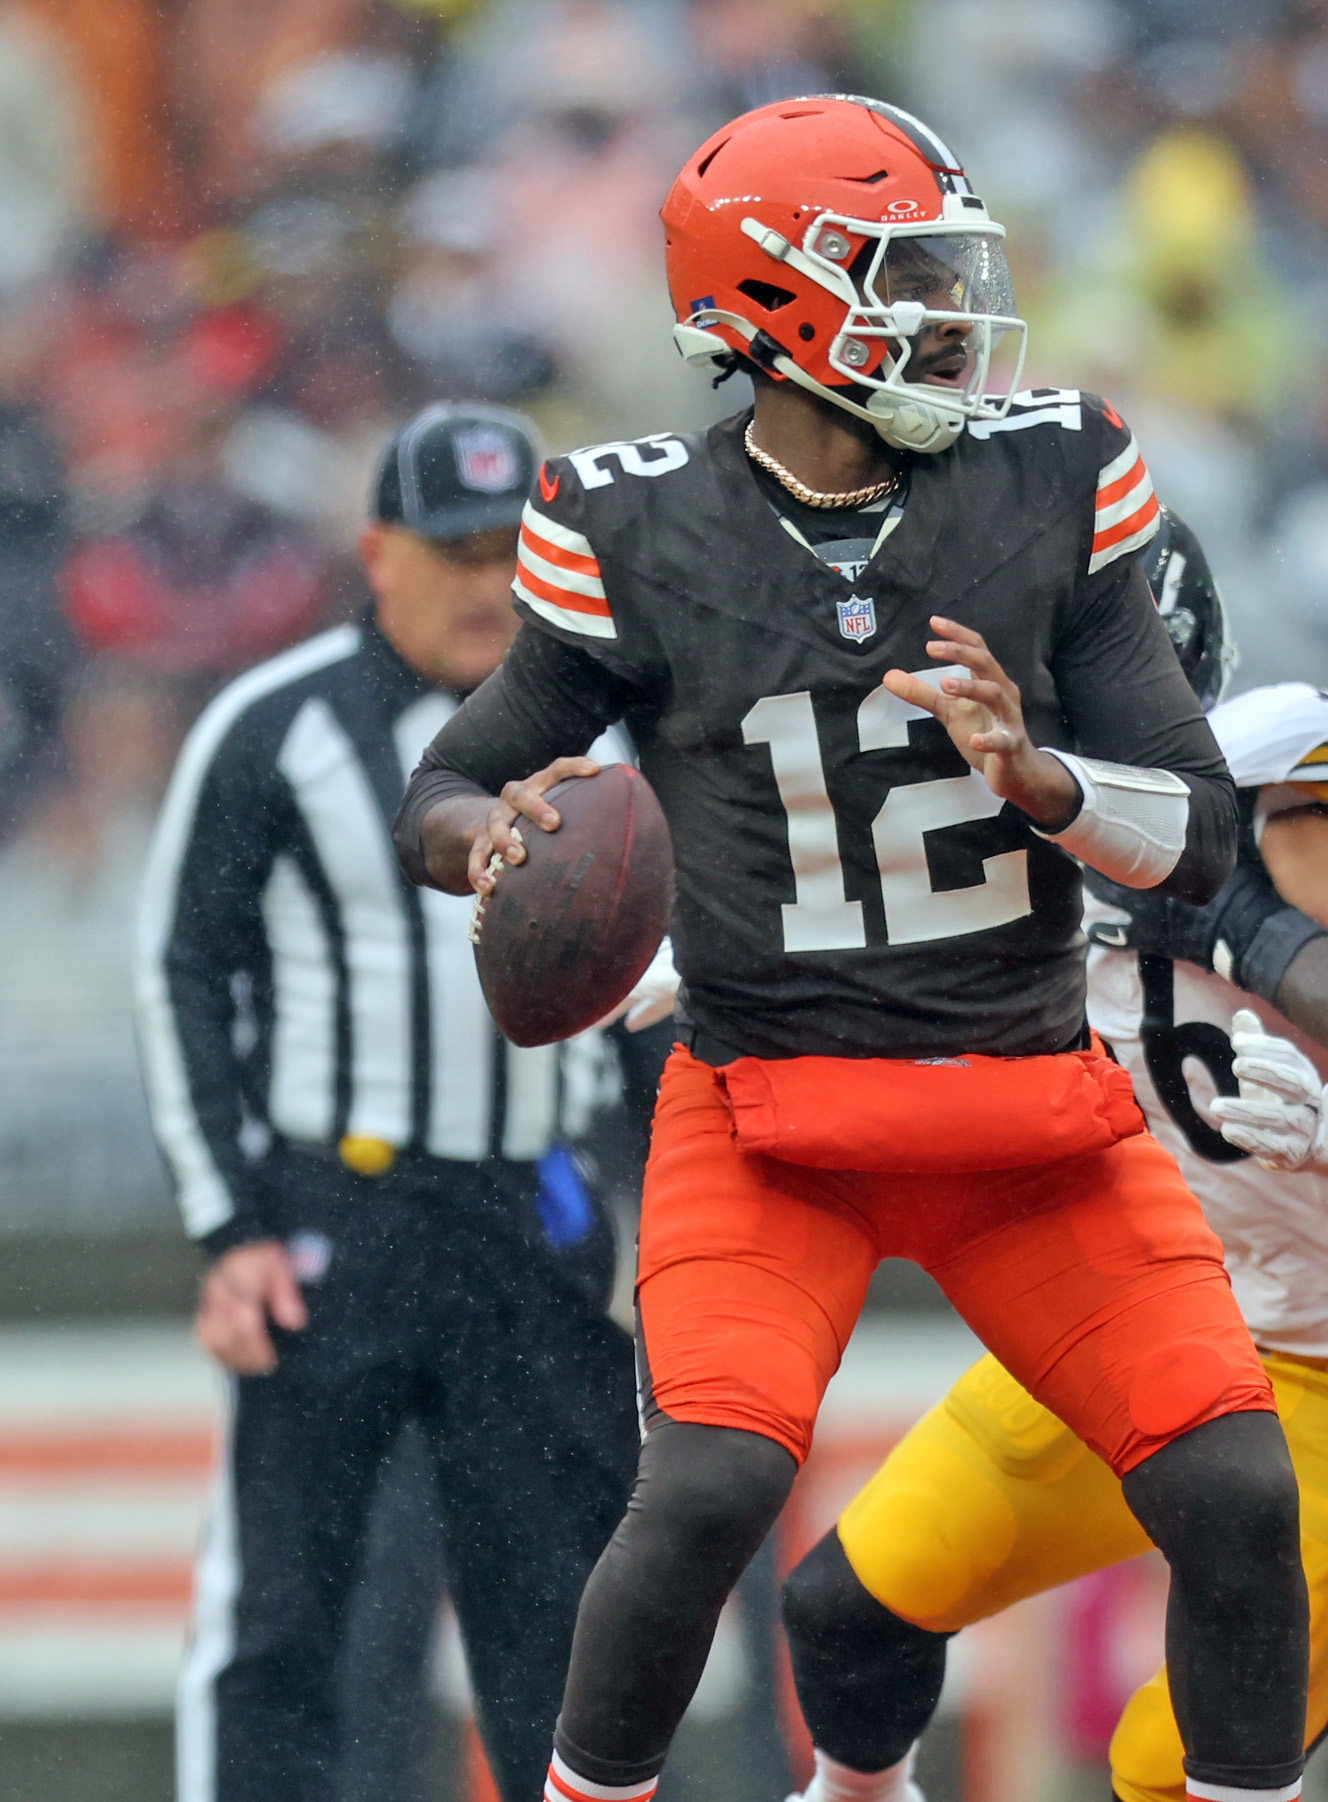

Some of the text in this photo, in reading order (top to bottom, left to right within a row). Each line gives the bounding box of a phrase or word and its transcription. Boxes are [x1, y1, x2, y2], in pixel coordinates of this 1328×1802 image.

[880, 210, 928, 222] OAKLEY
[844, 615, 872, 635] NFL
[740, 664, 1032, 954] 12
